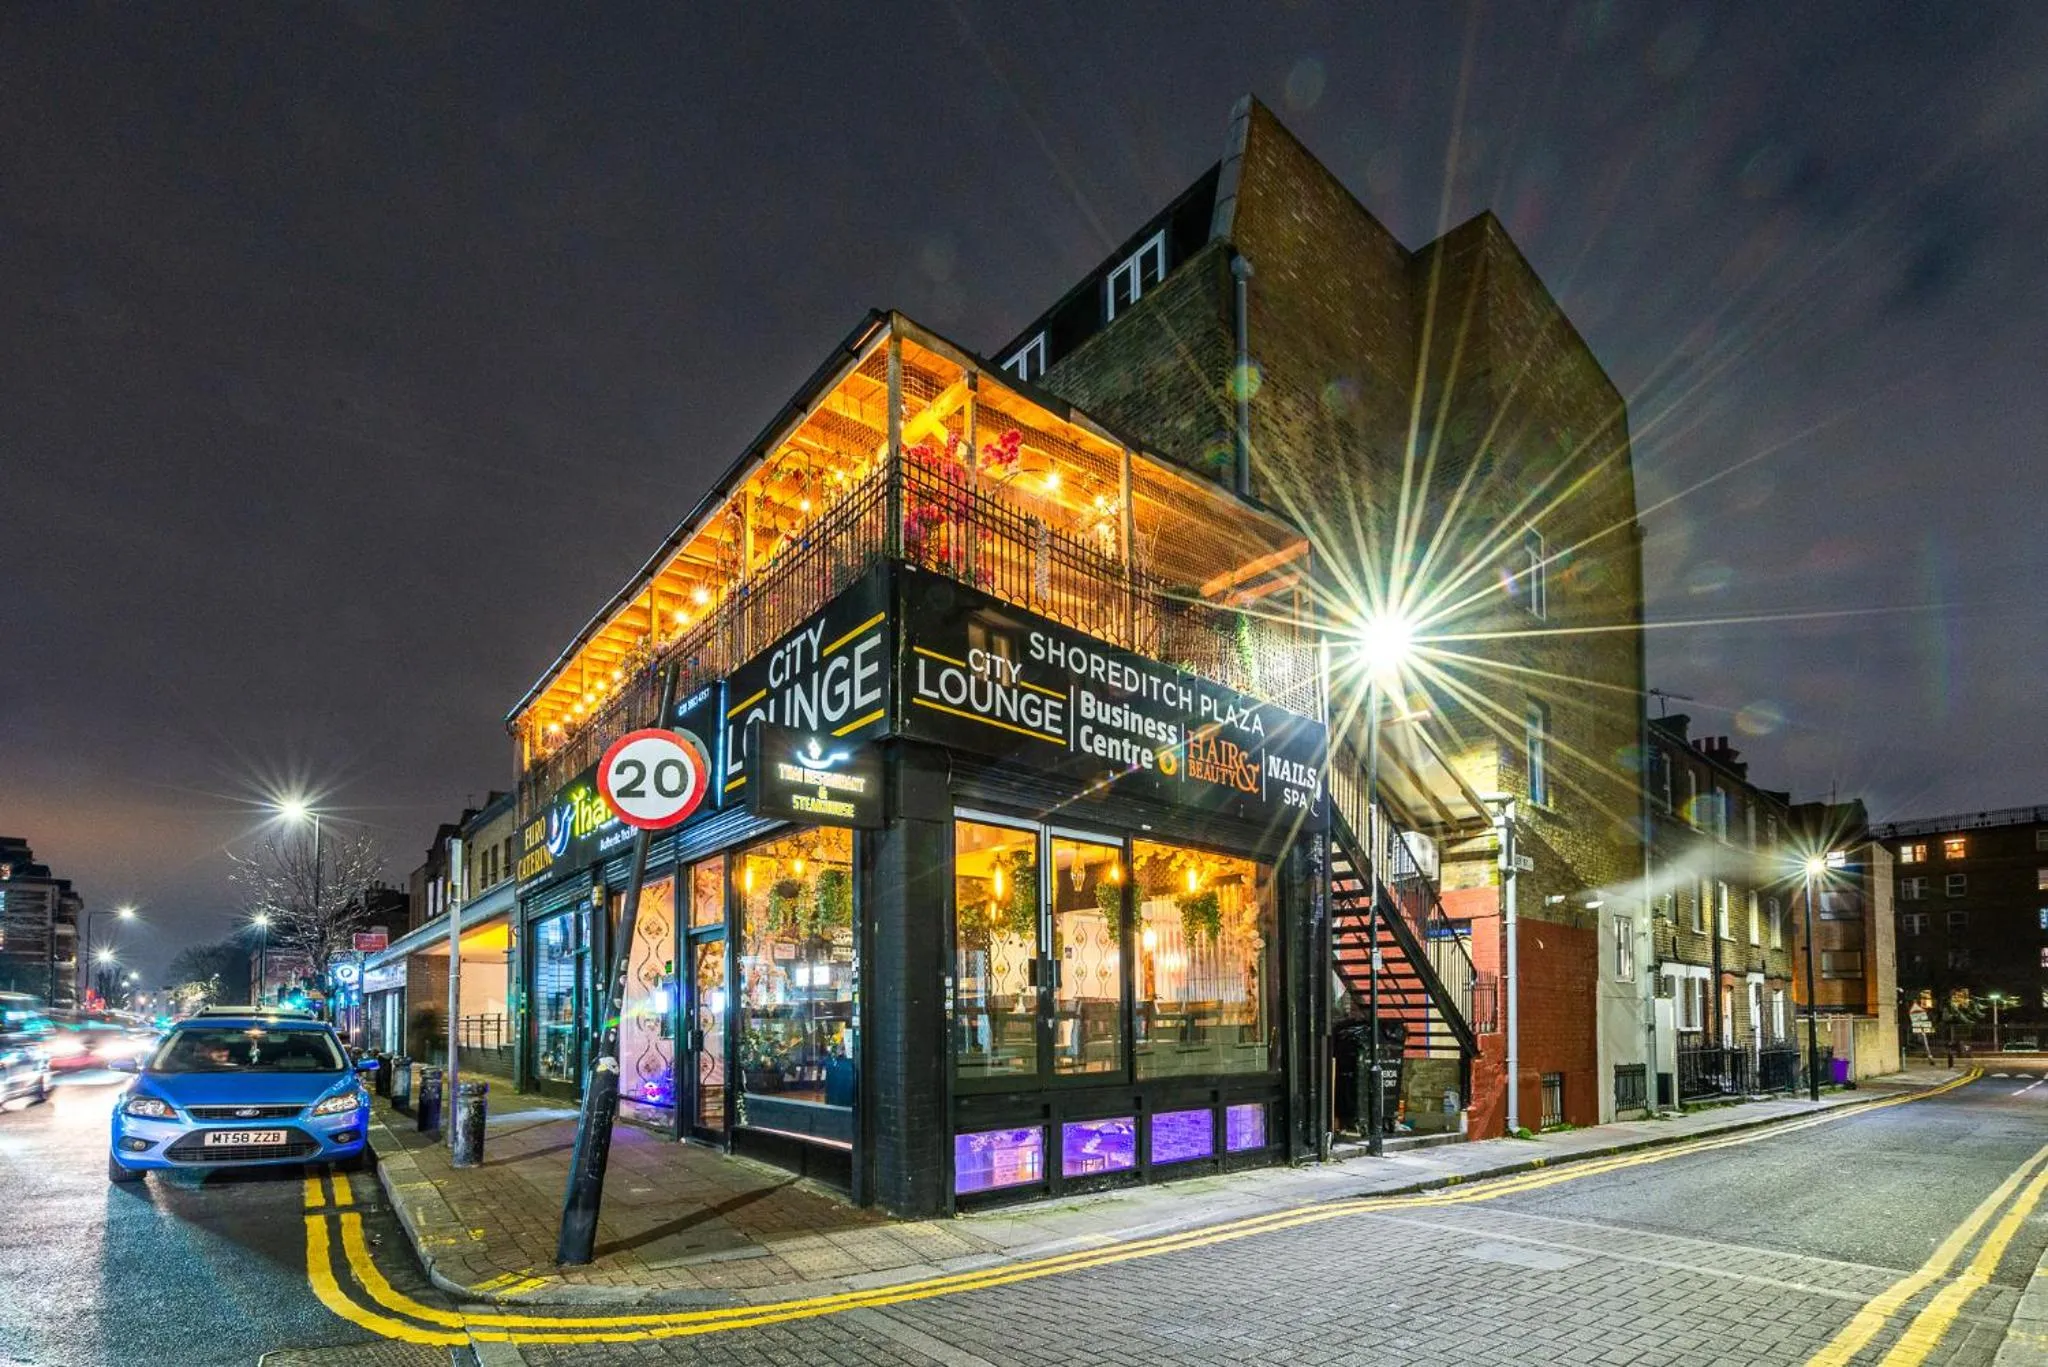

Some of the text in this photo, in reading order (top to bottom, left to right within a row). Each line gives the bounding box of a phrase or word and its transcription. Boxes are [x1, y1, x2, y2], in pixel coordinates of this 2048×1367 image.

[918, 657, 1064, 735] LOUNGE
[1029, 631, 1265, 738] SHOREDITCH PLAZA
[1080, 690, 1178, 745] Business
[1079, 724, 1154, 770] Centre
[1188, 730, 1260, 795] HAIR &
[615, 758, 689, 798] 20
[1188, 758, 1237, 788] BEAUTY
[1268, 755, 1317, 789] NAILS
[1283, 787, 1308, 809] SPA
[524, 815, 546, 851] EURO
[212, 1132, 280, 1143] MT58 ZZB
